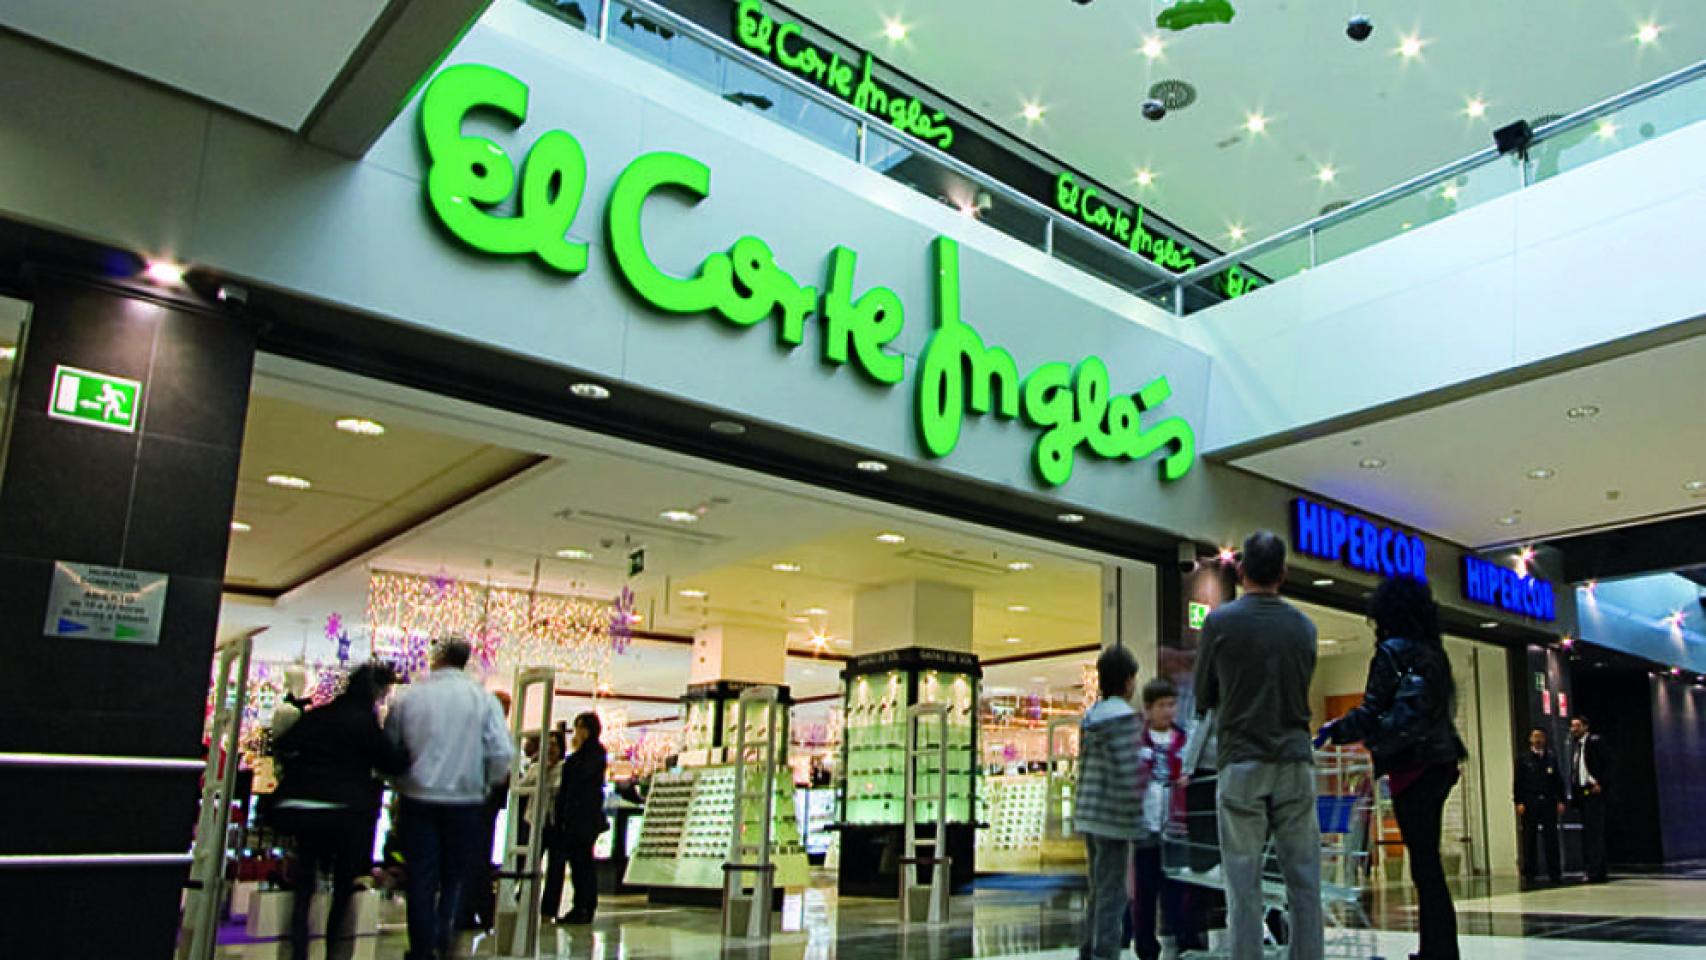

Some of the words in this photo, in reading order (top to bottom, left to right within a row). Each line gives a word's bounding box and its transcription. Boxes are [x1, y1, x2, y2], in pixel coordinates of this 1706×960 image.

[737, 0, 774, 55] El
[776, 20, 854, 97] Corte
[853, 52, 955, 150] Inglés
[1057, 172, 1079, 213] El
[1082, 188, 1130, 241] Corte
[1130, 205, 1197, 273] Inglés
[416, 63, 590, 275] El
[606, 150, 904, 386] Corte
[916, 234, 1196, 487] Inglés
[1296, 498, 1427, 583] HIPERCOR
[1465, 556, 1555, 621] HIPERCOR
